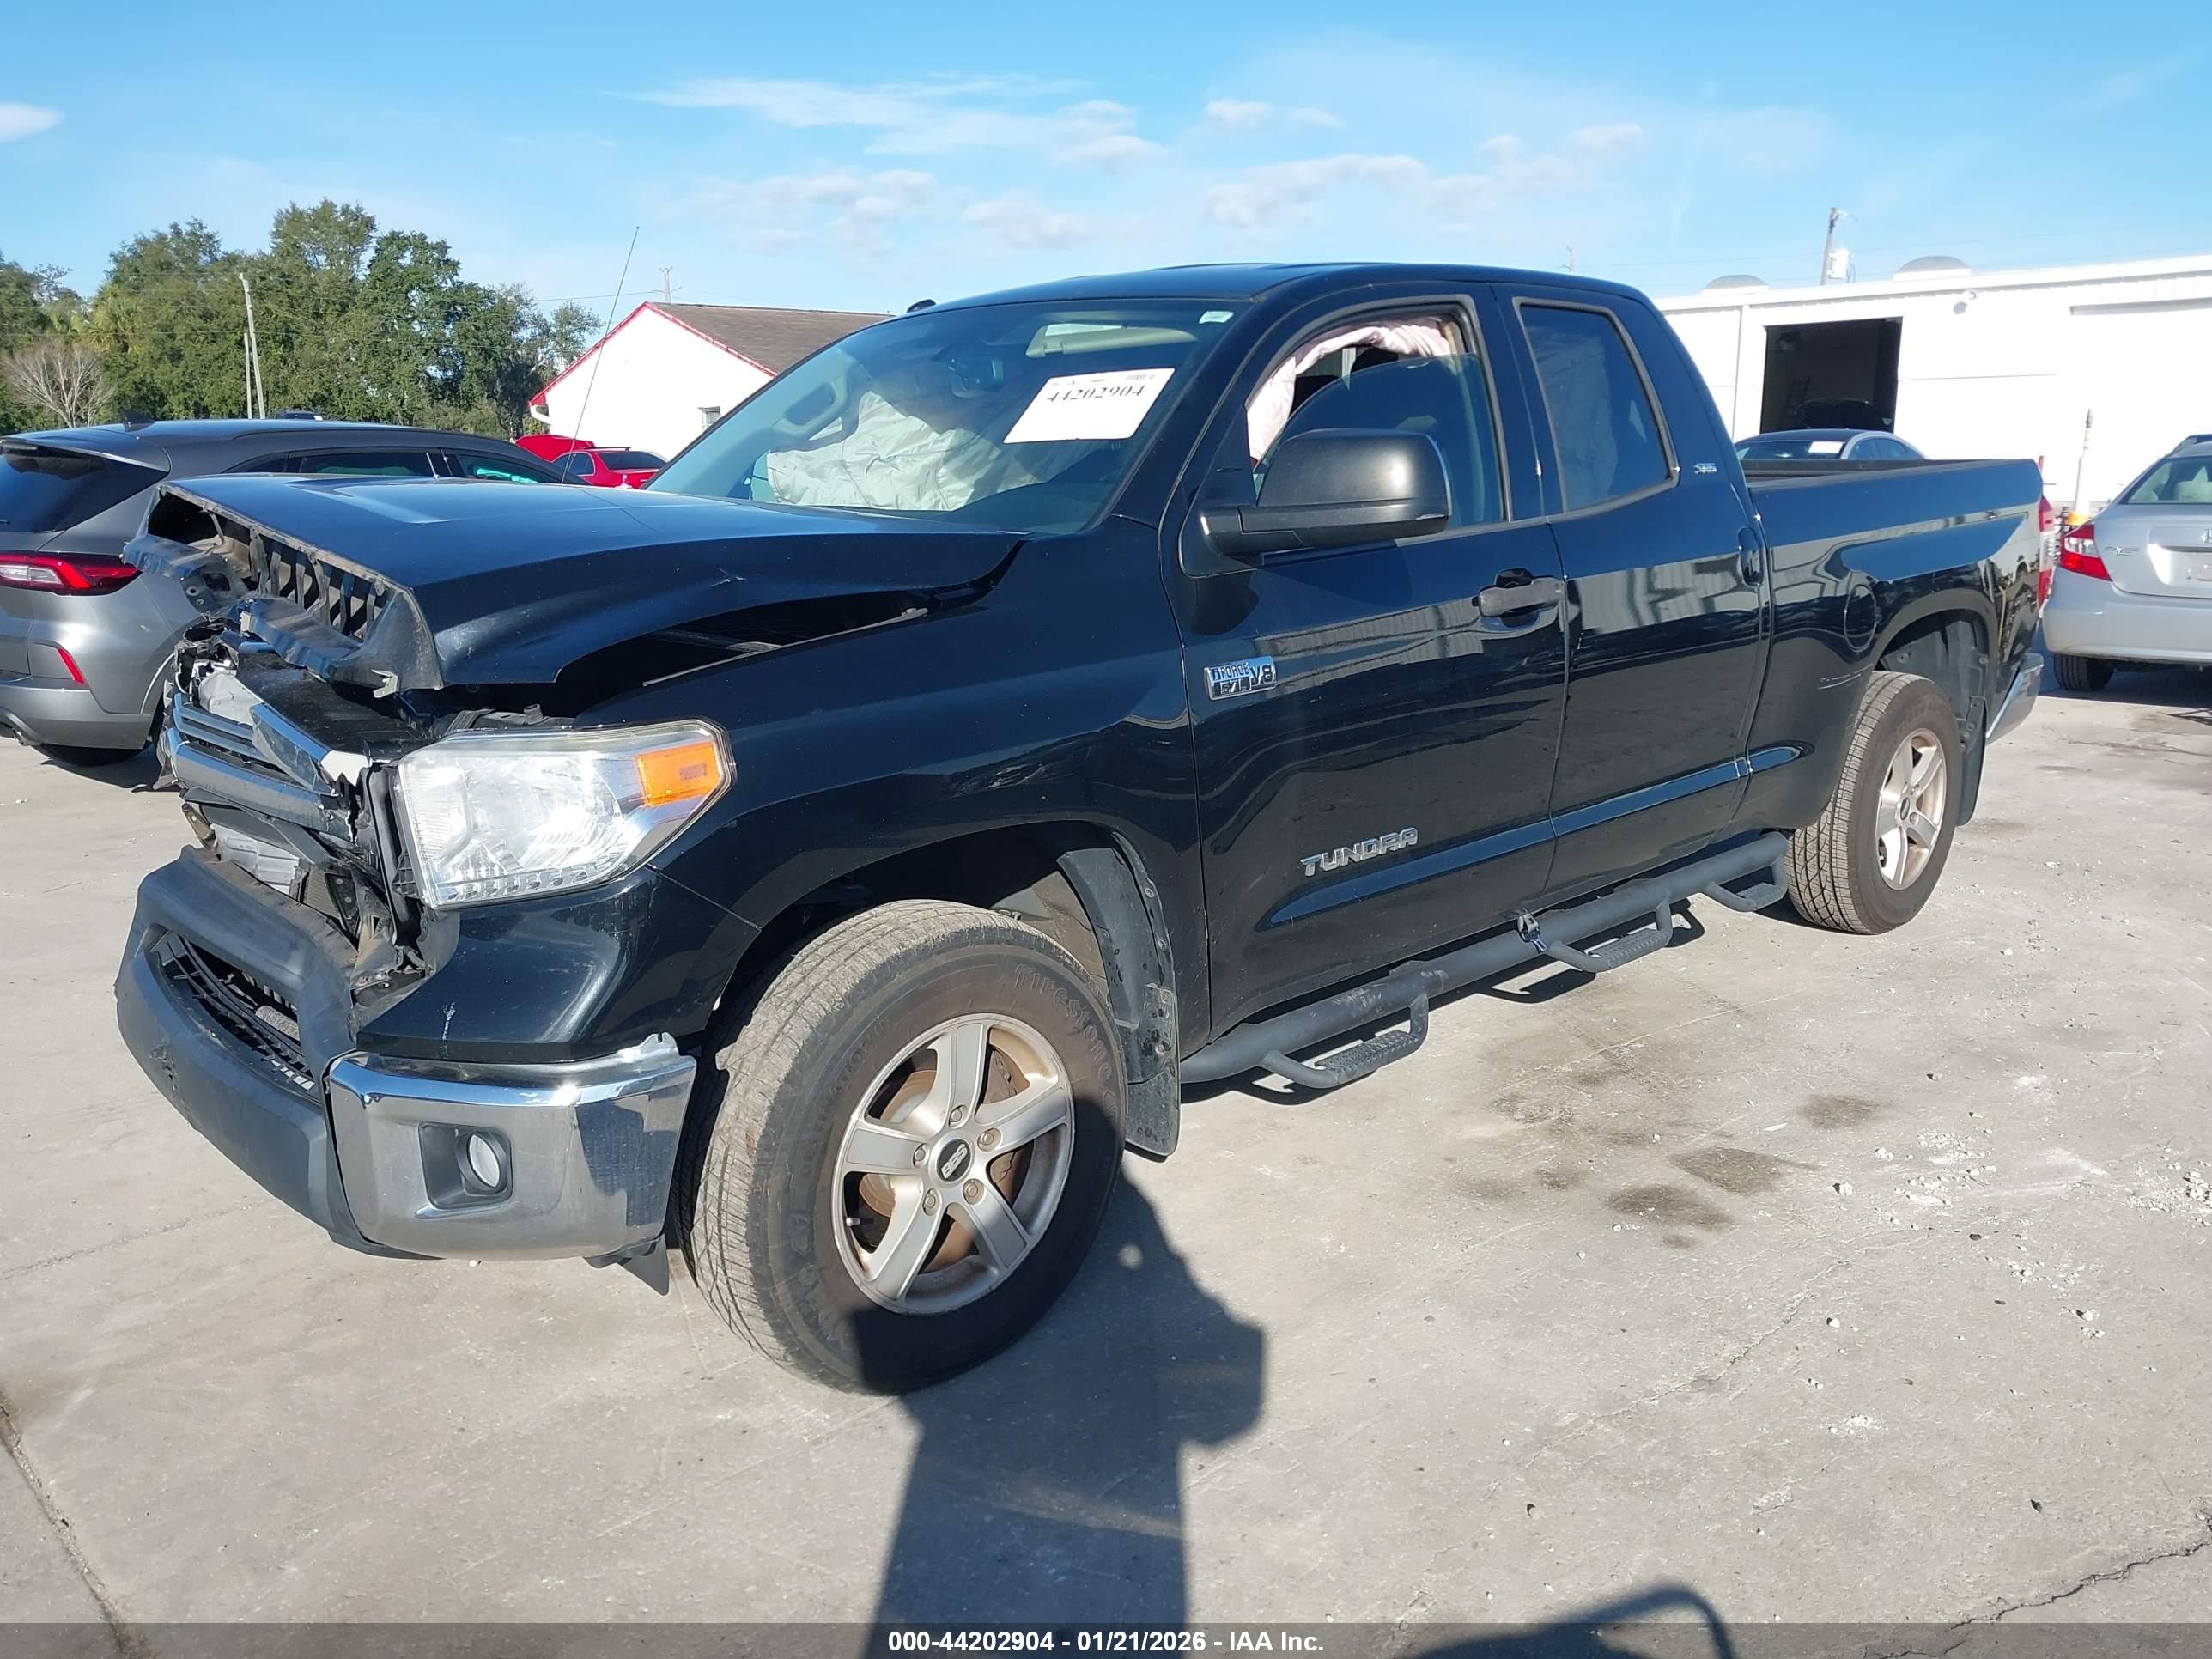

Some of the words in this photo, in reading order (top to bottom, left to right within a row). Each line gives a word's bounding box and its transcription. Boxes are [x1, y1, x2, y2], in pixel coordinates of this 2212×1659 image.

[1047, 384, 1146, 402] 44202904
[1300, 827, 1418, 877] TUNDRA
[940, 1143, 968, 1179] BBS
